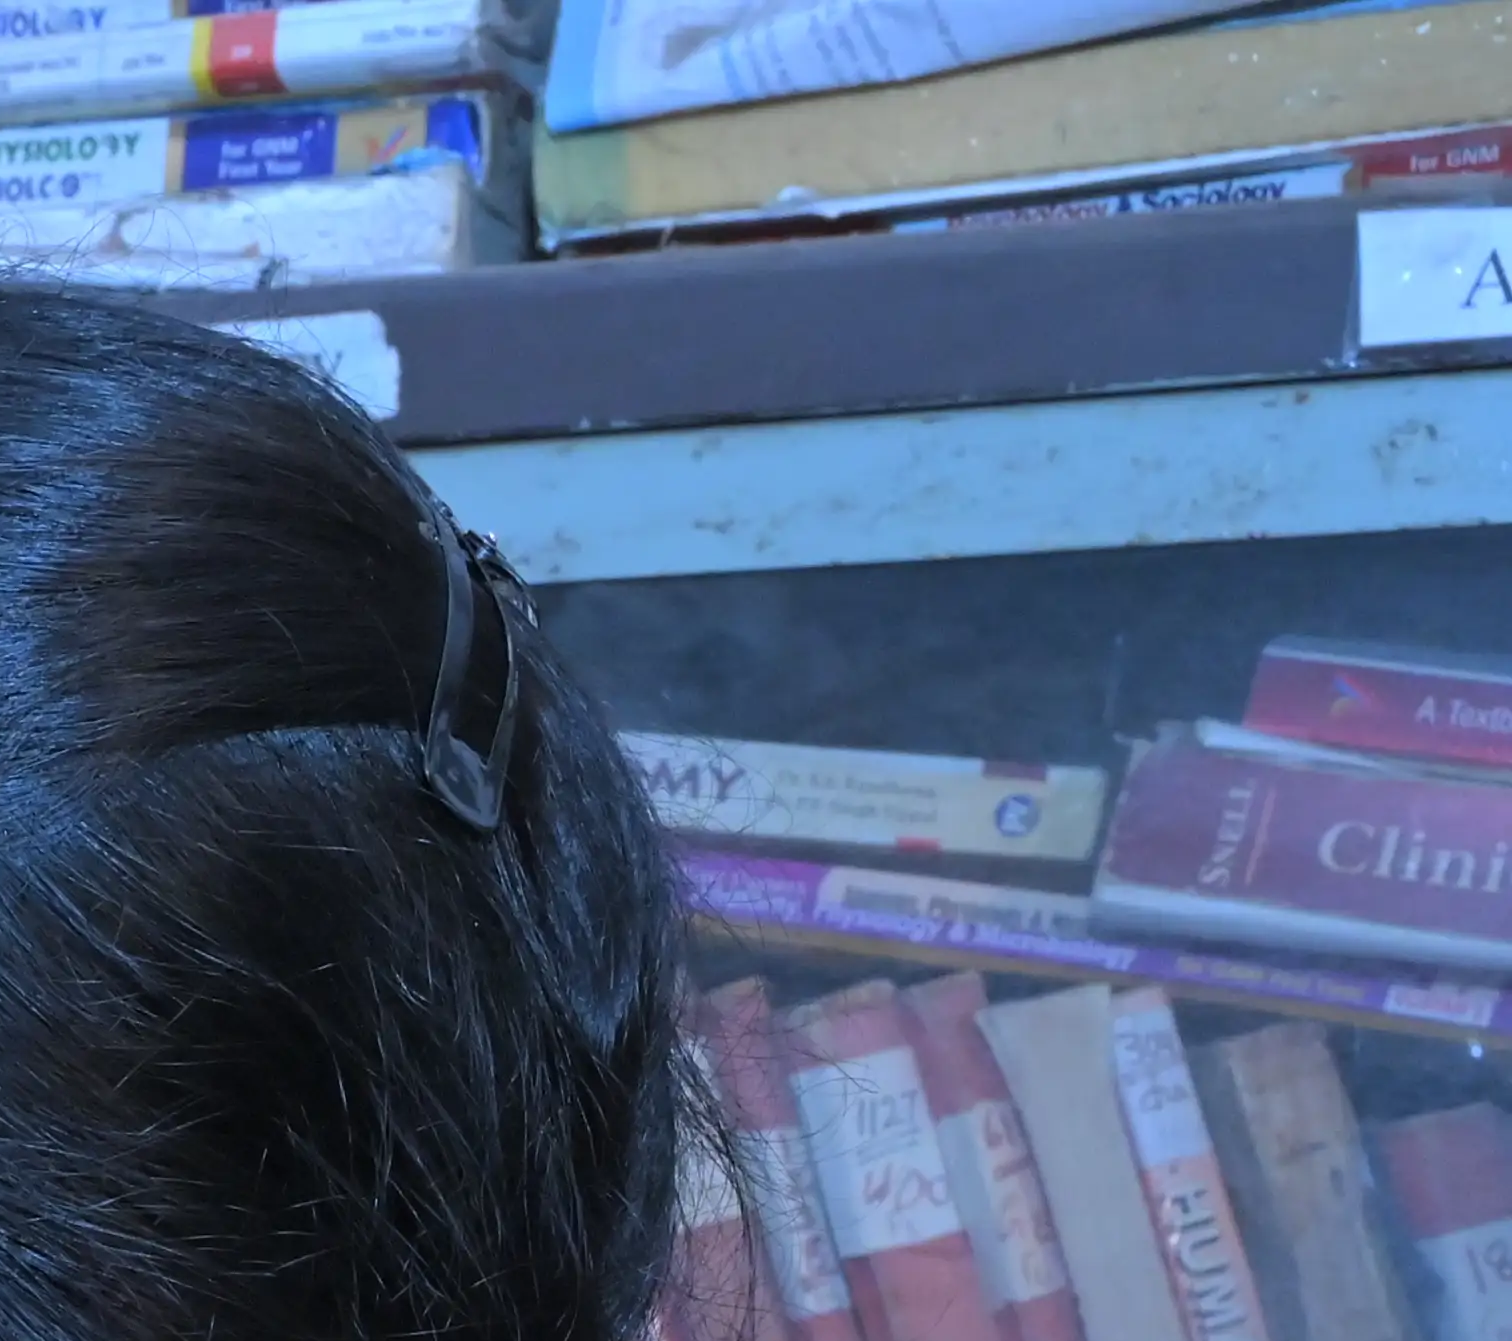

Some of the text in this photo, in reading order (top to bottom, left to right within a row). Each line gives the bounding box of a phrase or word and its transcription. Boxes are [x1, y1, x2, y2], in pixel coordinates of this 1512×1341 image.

[1409, 145, 1500, 172] for GNM
[1414, 696, 1435, 726] A
[1318, 821, 1512, 893] Clini
